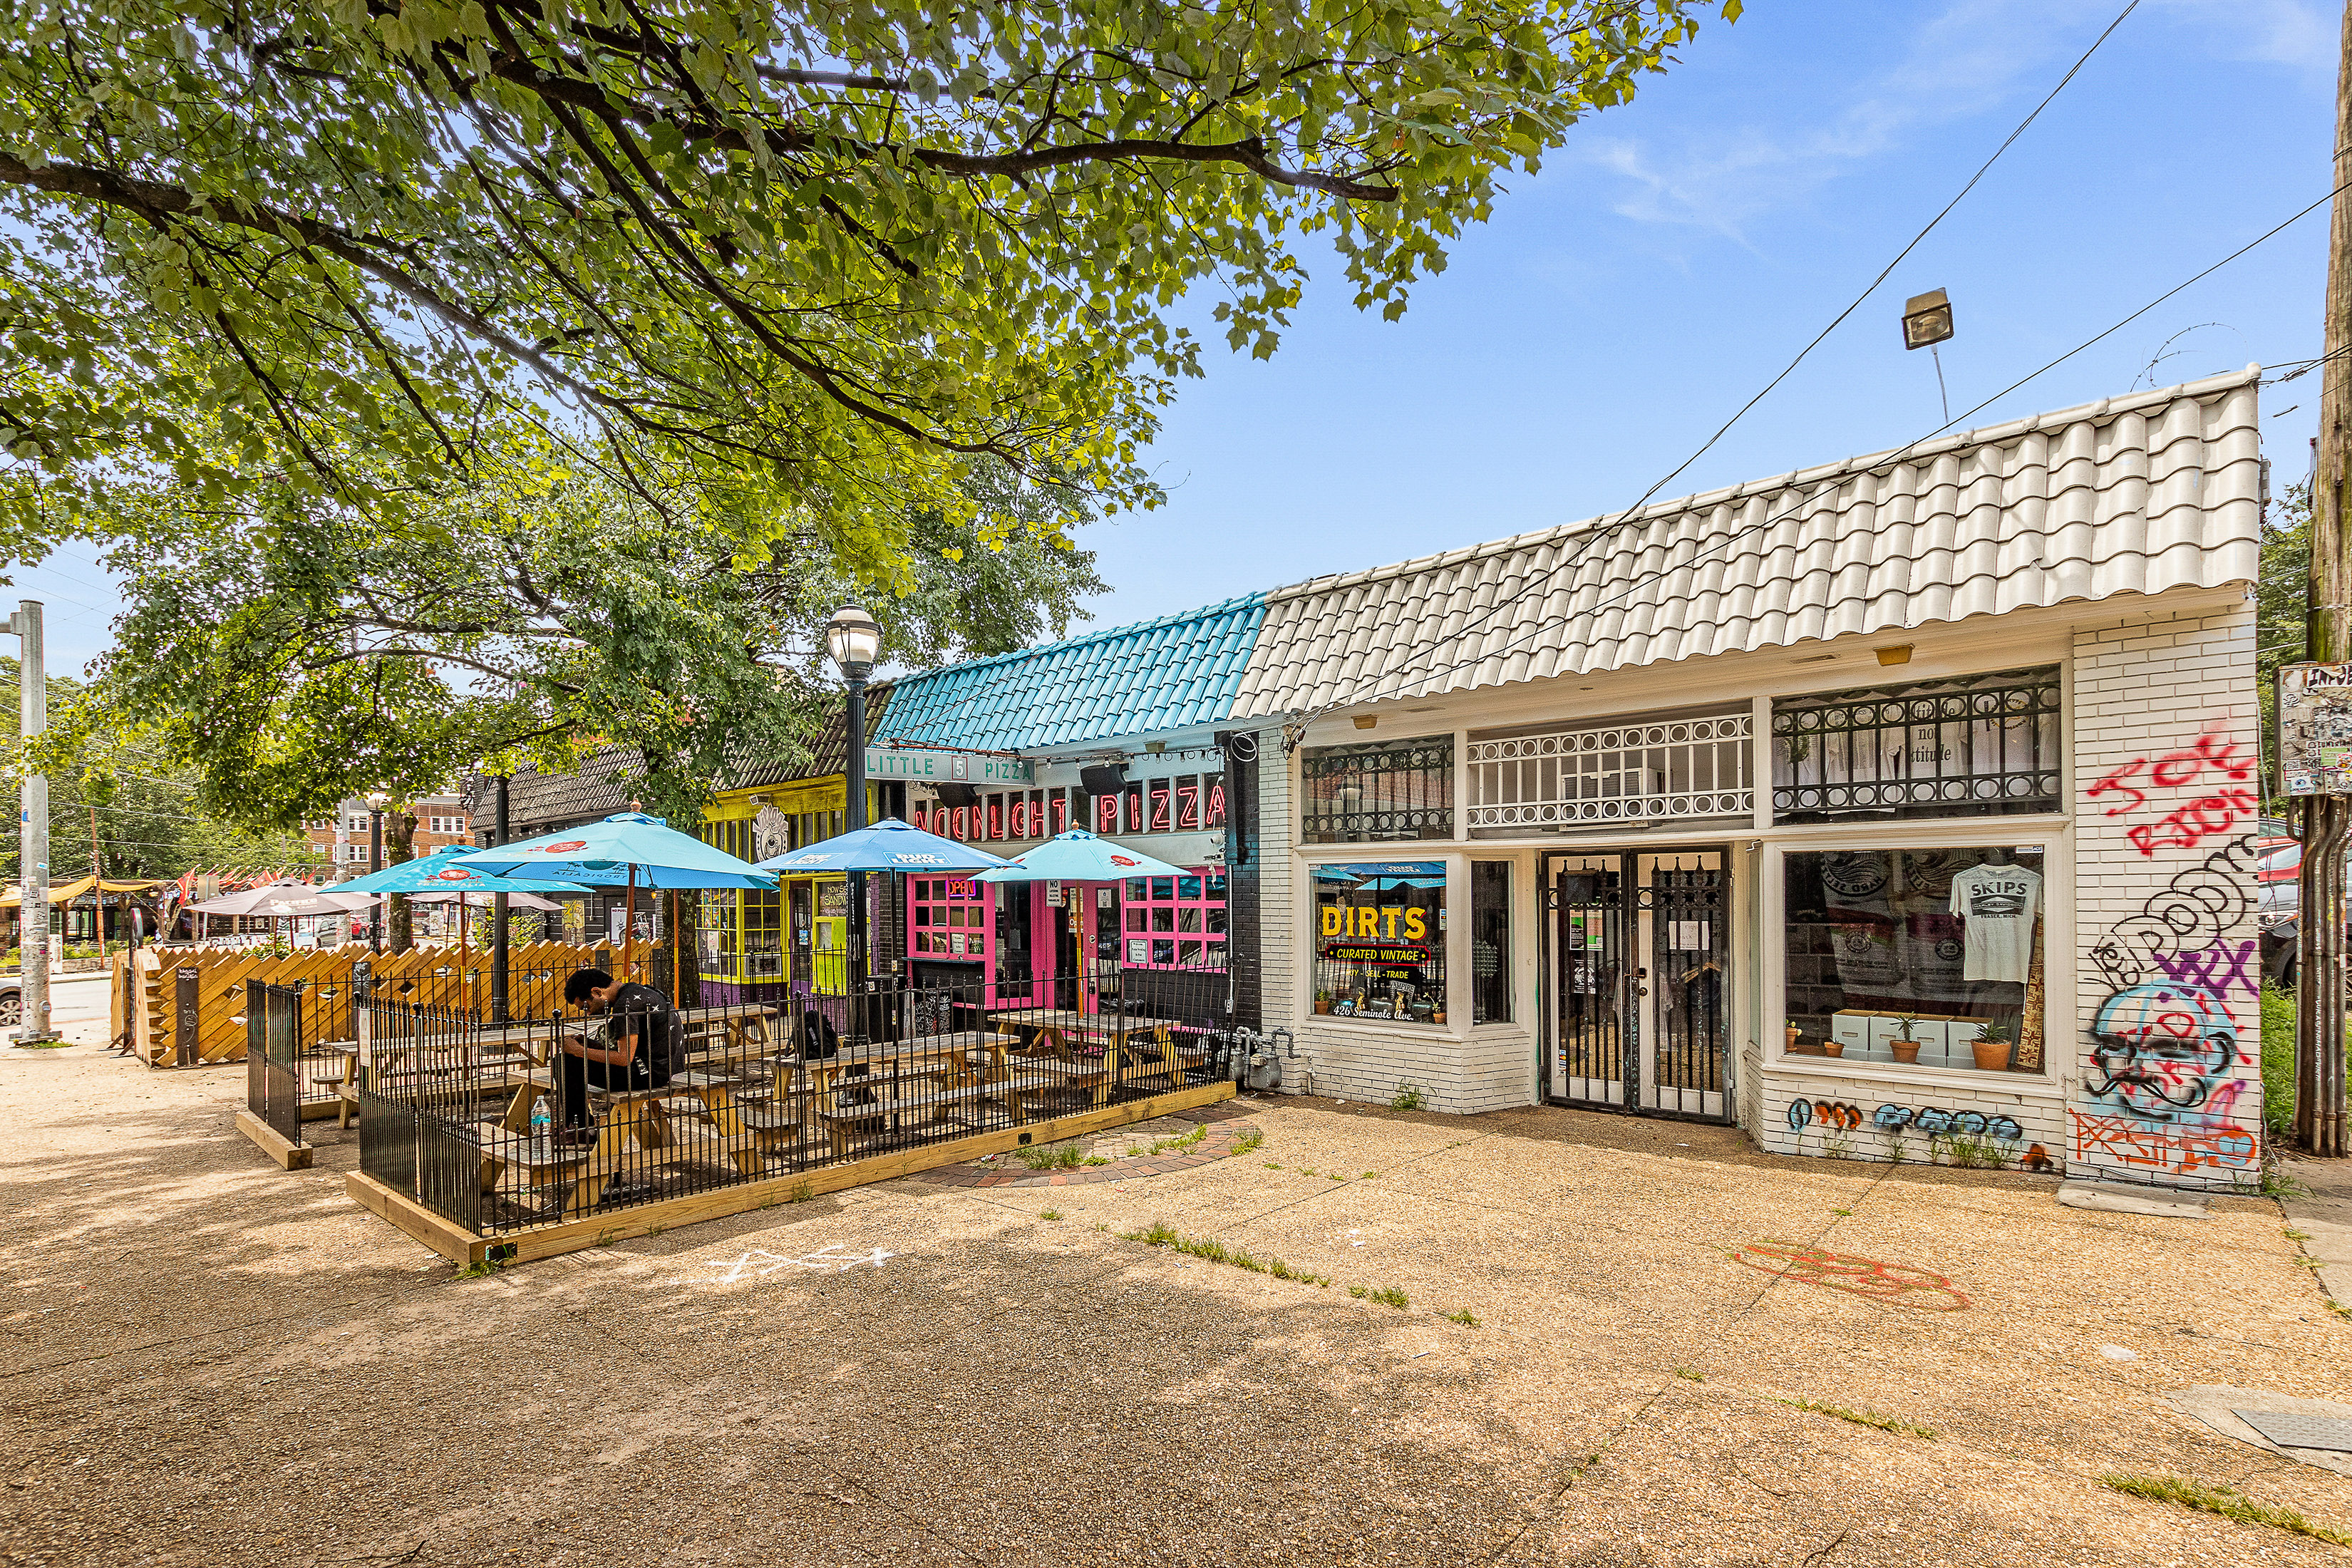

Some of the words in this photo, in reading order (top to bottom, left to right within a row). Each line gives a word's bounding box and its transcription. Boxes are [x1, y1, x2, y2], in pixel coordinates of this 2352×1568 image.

[1918, 726, 1936, 741] no
[867, 754, 933, 775] LITTLE
[956, 760, 964, 777] 5
[985, 761, 1031, 780] PIZZA
[915, 798, 1066, 840] MOONLGHT
[1100, 785, 1225, 832] PIZZA
[1050, 880, 1058, 888] NO
[1971, 881, 2028, 897] SKIPS
[1321, 906, 1427, 941] DIRTS
[1336, 948, 1378, 960] CURATED
[1380, 949, 1420, 961] VINTAGE
[1345, 969, 1359, 978] BUY
[1365, 969, 1381, 979] SELL
[1386, 970, 1409, 979] TRADE
[1334, 1005, 1351, 1016] 426
[1352, 1006, 1392, 1019] Seminole
[1394, 1007, 1415, 1021] Ave.
